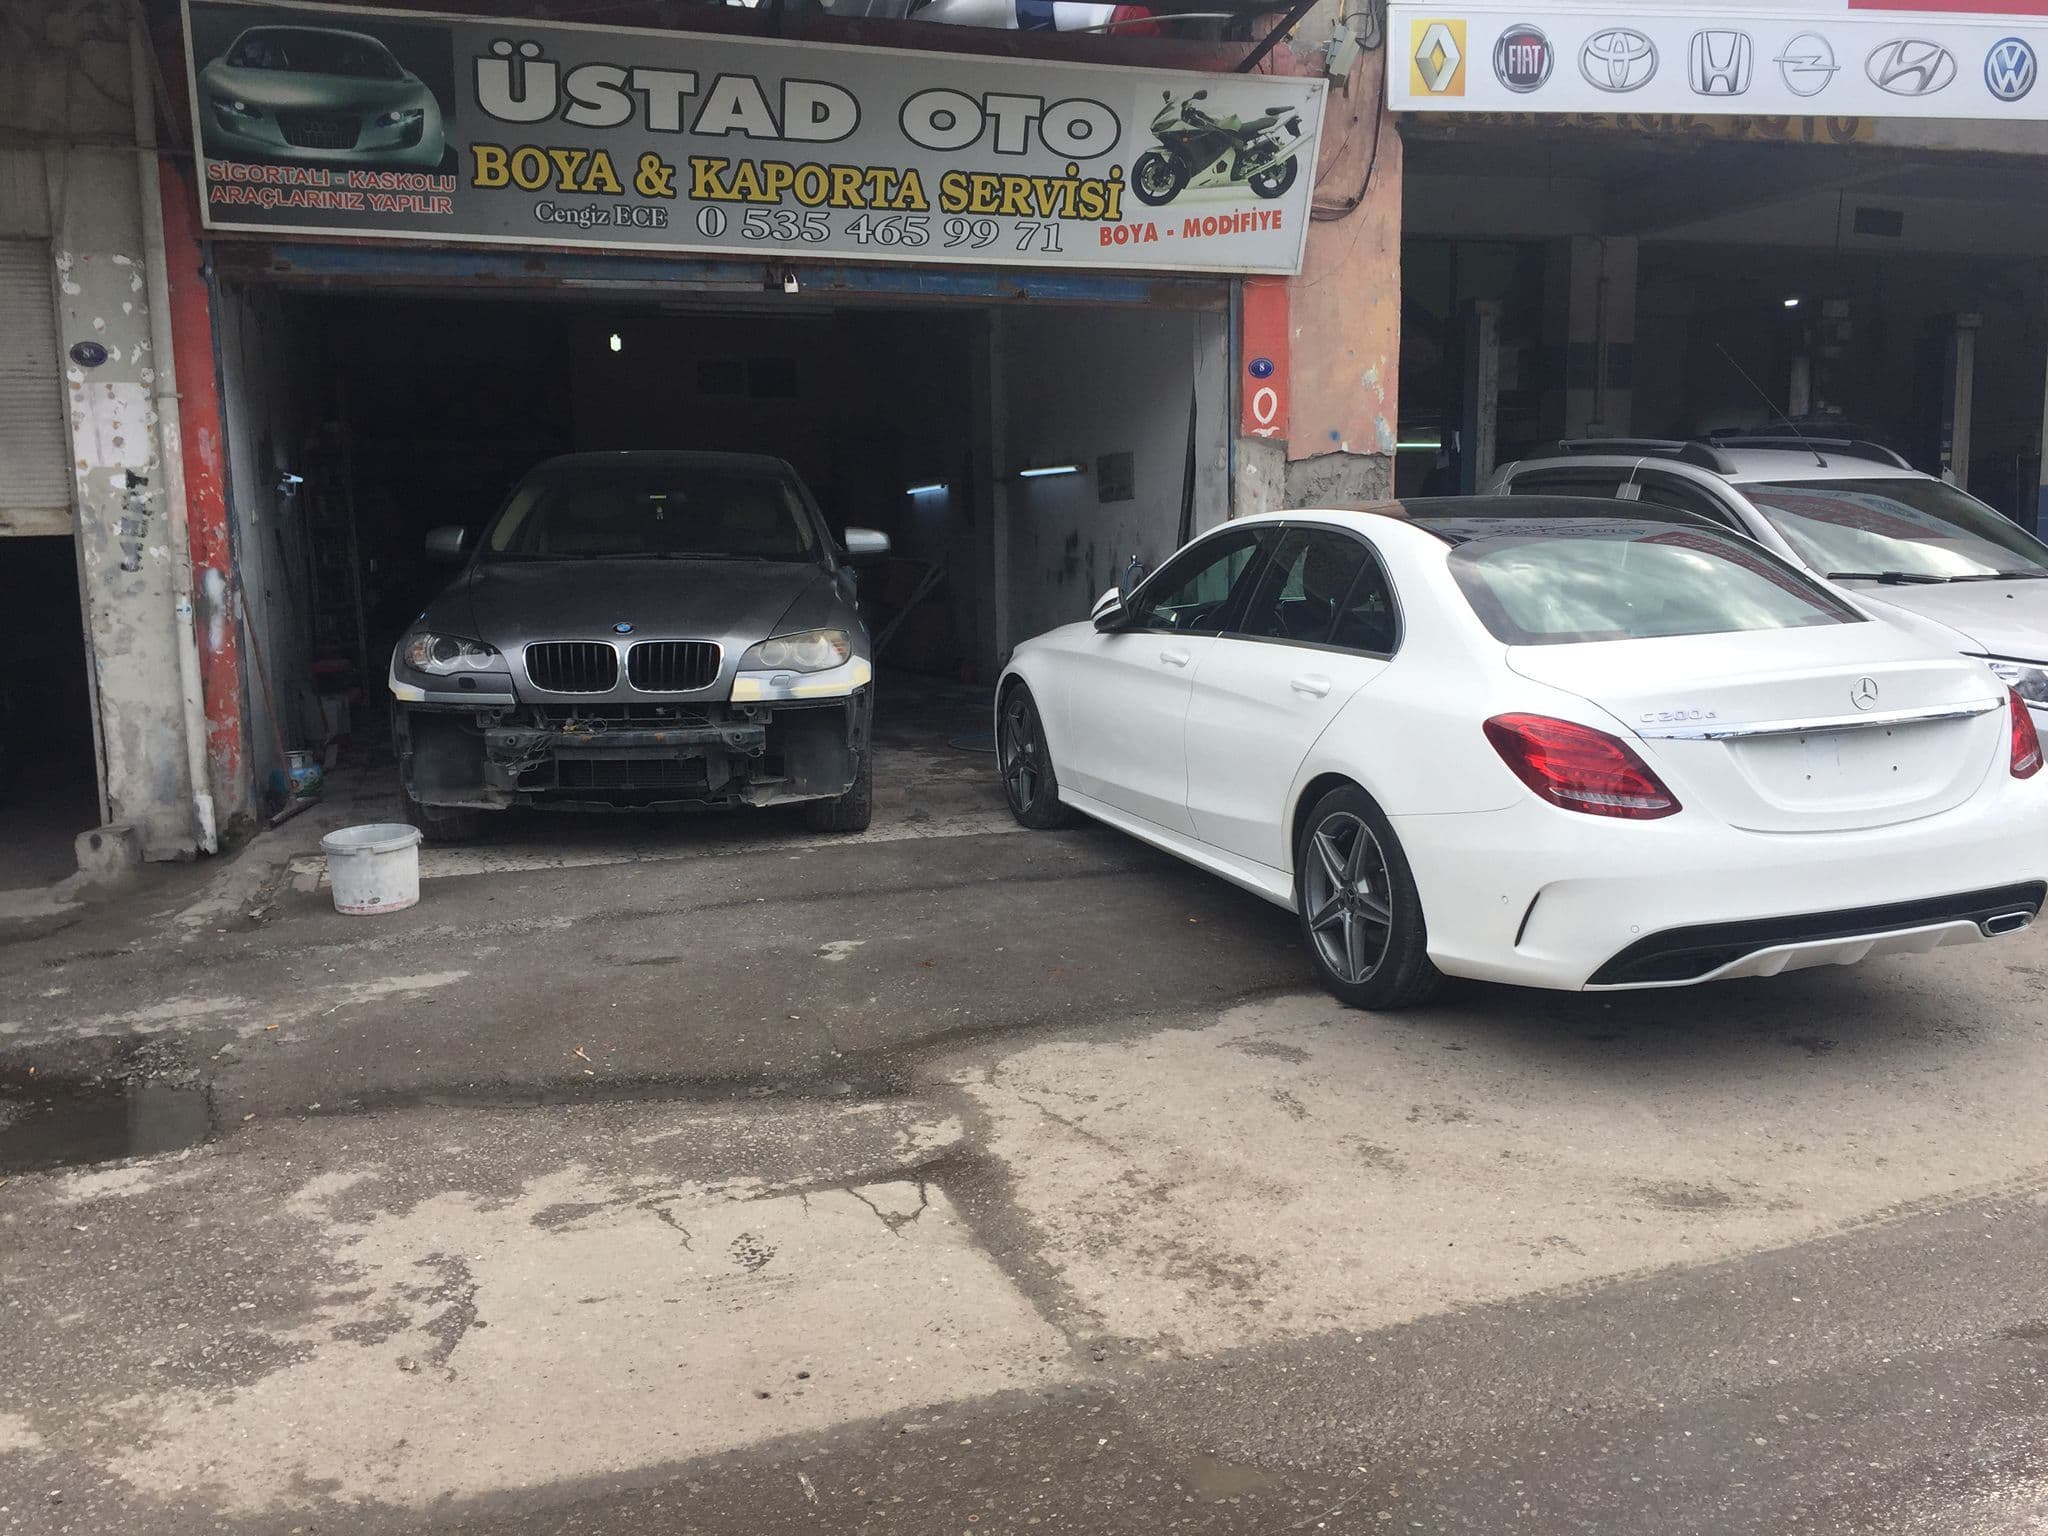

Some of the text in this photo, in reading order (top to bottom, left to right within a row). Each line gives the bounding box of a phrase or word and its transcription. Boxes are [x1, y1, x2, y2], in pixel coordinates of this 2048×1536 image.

[1508, 45, 1542, 74] FIAT
[473, 39, 1121, 159] ÜSTAD OTO
[208, 161, 330, 186] SİGORTALI
[349, 170, 456, 192] KASKOLU
[471, 143, 1126, 221] BOYA & KAPORTA SERVİSİ
[210, 186, 453, 214] ARAÇLARINIZ YAPILIR
[534, 201, 668, 228] Cengiz ECE
[697, 206, 1063, 252] 0 535 465 99 71
[1100, 222, 1158, 246] BOYA
[1182, 206, 1282, 239] MODİFİYE
